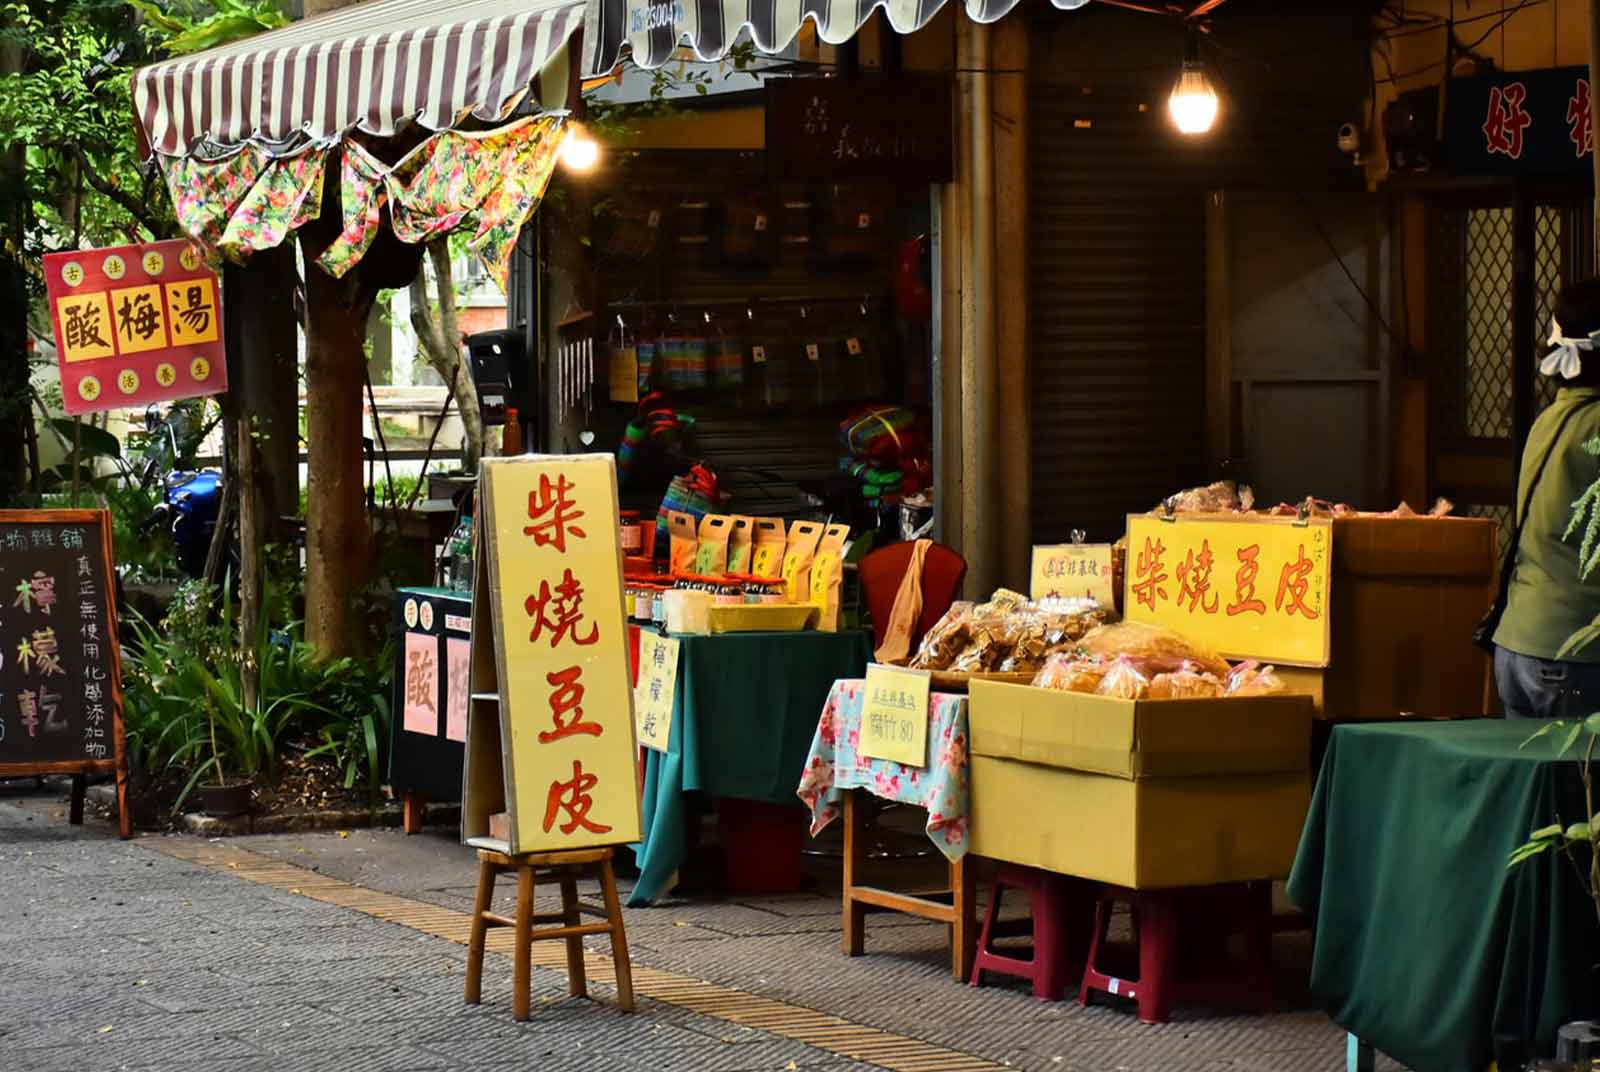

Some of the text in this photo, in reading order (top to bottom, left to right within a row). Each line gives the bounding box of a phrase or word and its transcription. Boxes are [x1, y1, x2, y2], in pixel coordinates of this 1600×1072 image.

[64, 286, 211, 350] 酸梅湯
[1132, 536, 1319, 620] 柴燒豆皮
[13, 570, 67, 737] 檸檬乾
[407, 650, 436, 714] 酸
[523, 473, 613, 835] 柴燒豆皮
